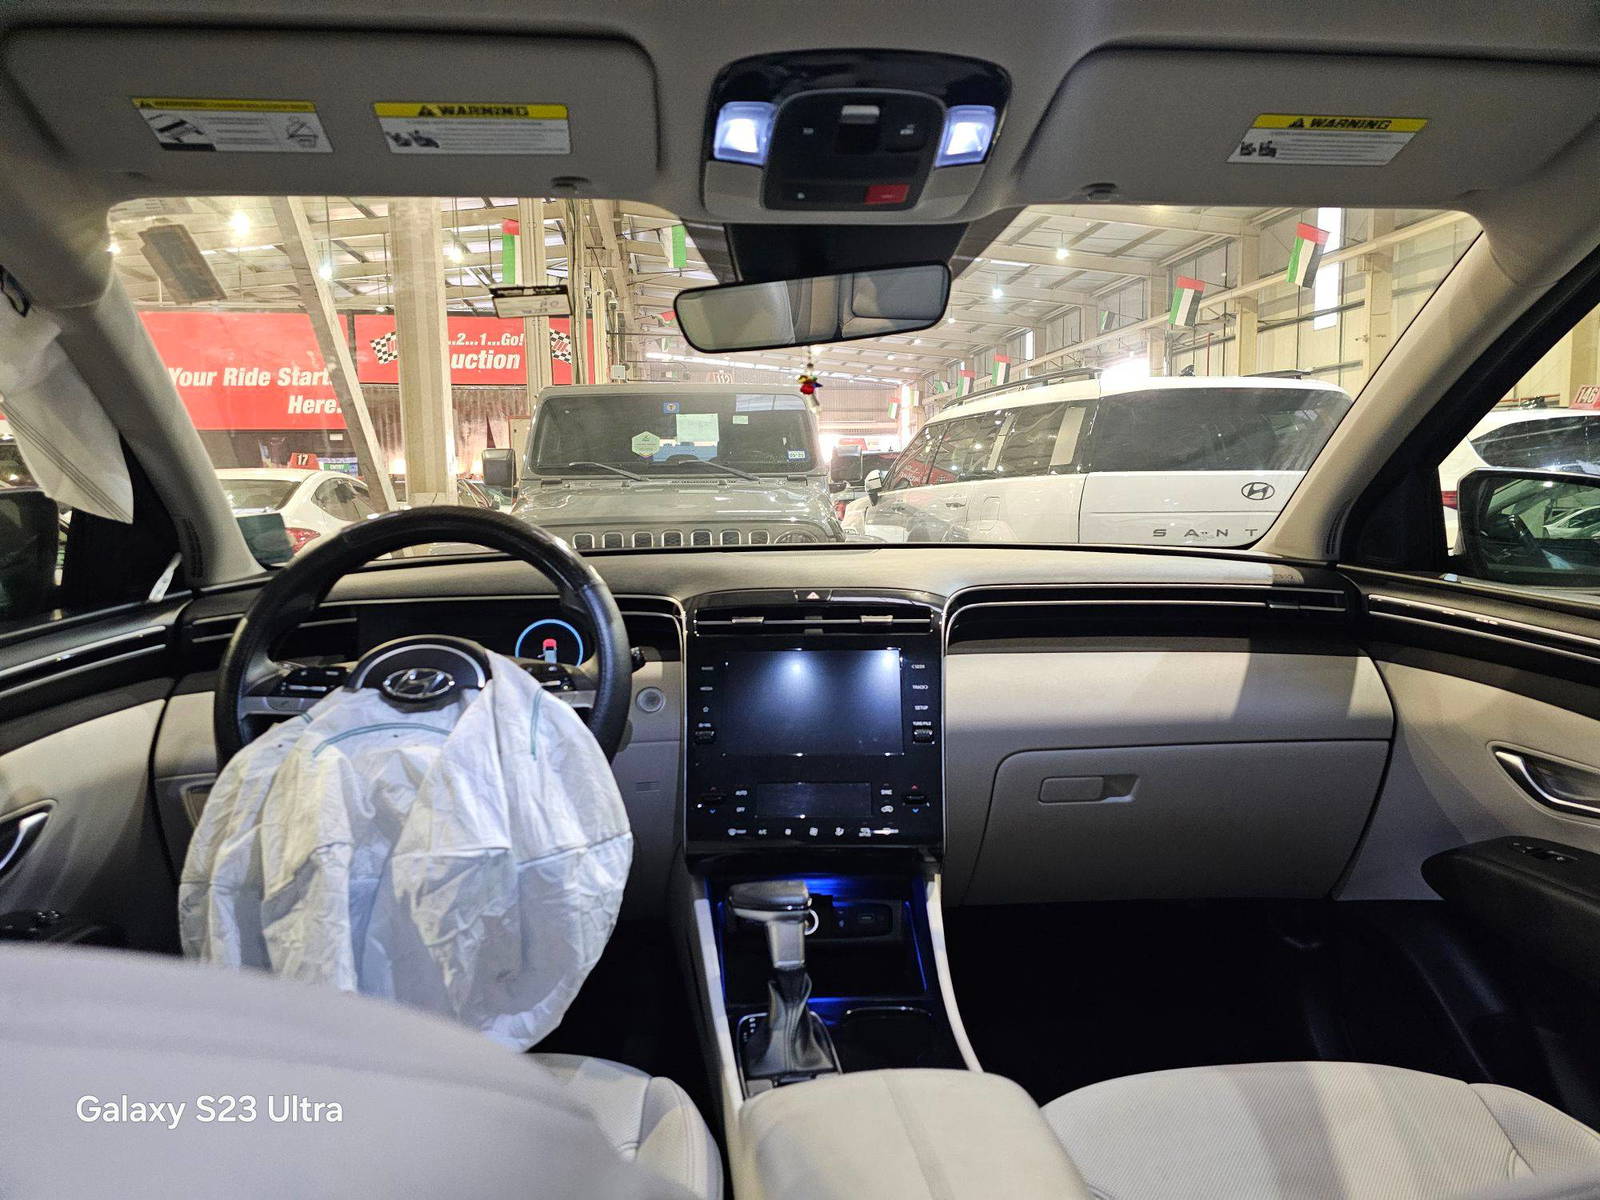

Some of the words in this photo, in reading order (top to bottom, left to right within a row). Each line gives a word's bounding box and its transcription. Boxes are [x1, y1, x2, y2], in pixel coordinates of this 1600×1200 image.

[438, 104, 528, 117] WARNING
[1309, 117, 1392, 130] WARNING
[451, 349, 520, 370] uction
[168, 367, 218, 387] Your
[222, 367, 272, 387] Ride
[297, 453, 308, 466] 17
[1153, 528, 1258, 537] SANT
